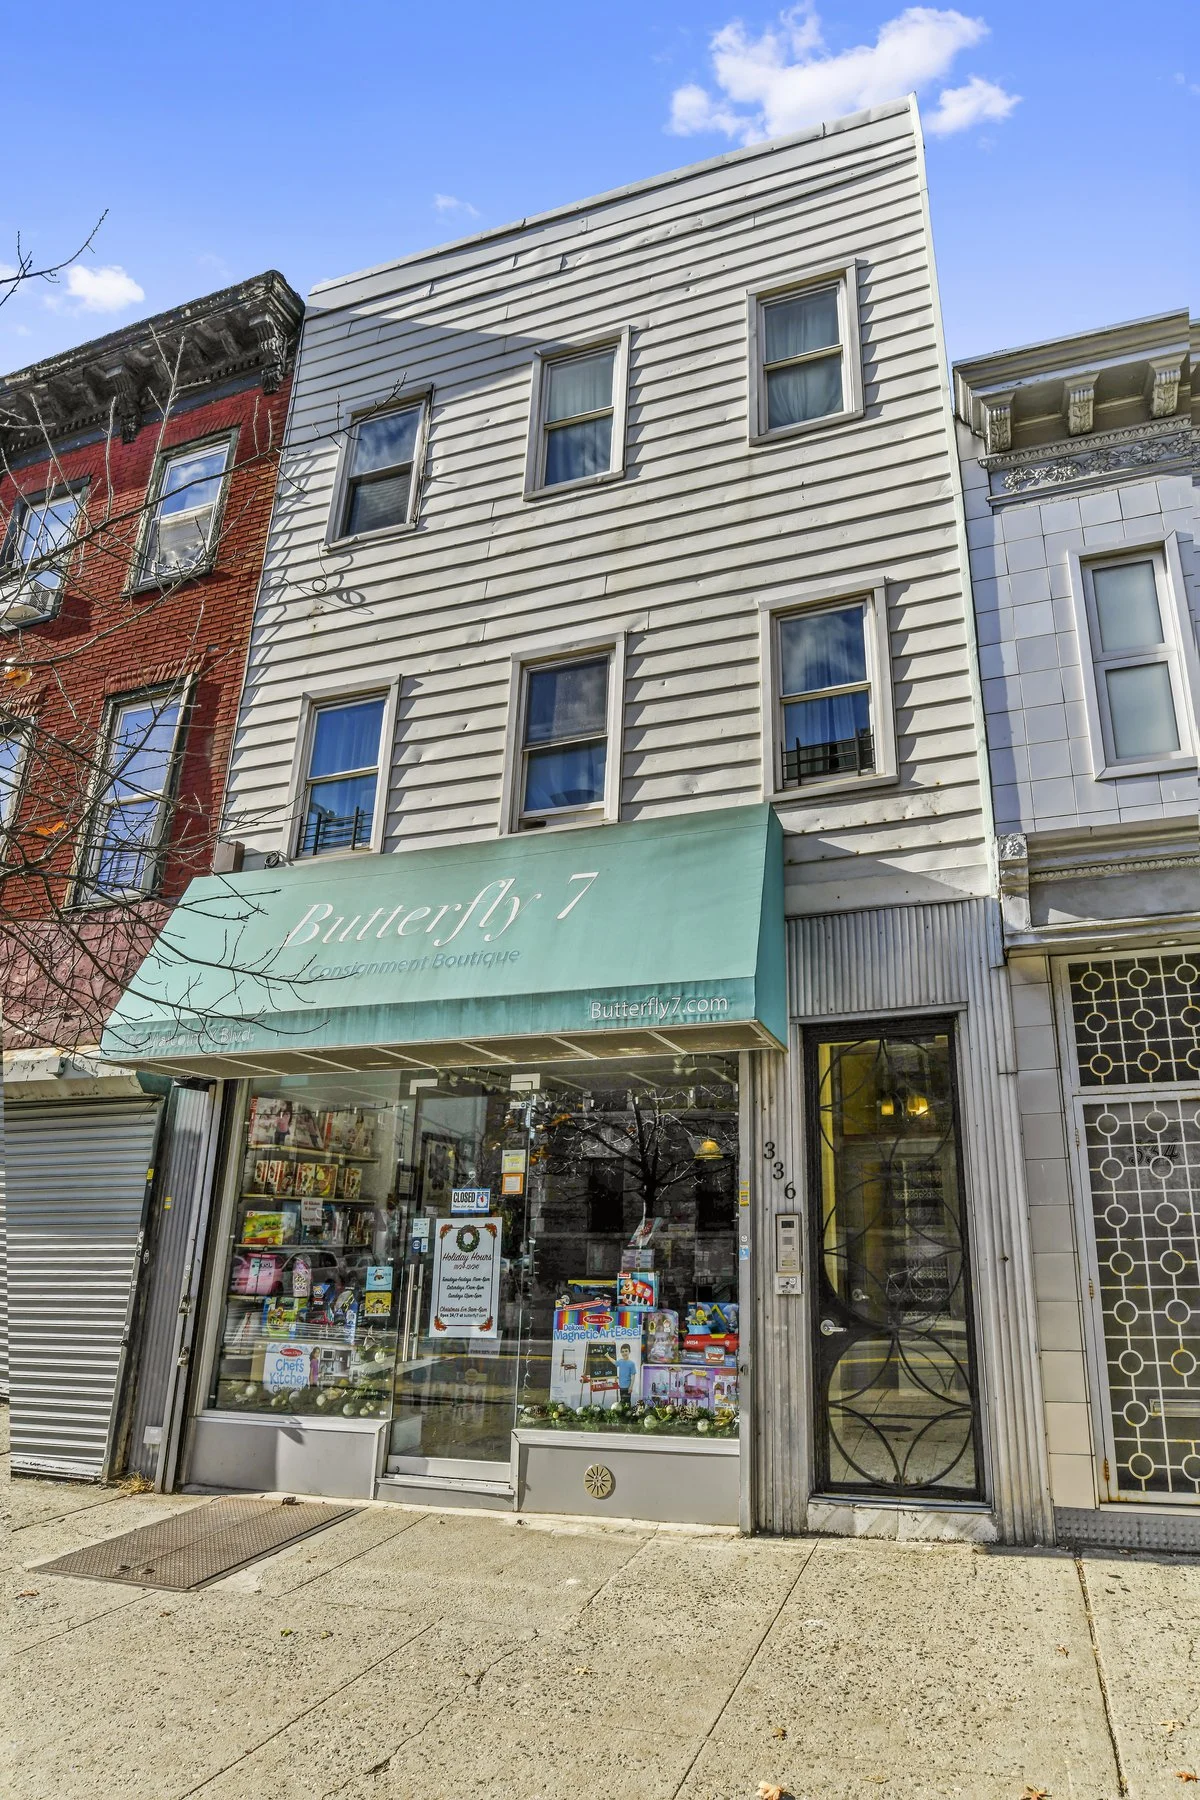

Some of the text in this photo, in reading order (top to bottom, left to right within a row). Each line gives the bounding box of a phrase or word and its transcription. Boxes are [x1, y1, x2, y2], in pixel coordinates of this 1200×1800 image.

[281, 871, 600, 948] Butterfly 7
[308, 948, 521, 980] Consignment Boutique
[591, 996, 728, 1020] Butterfly7.com
[763, 1141, 797, 1200] 336
[453, 1191, 476, 1203] CLOSED
[442, 1252, 492, 1266] Holiday Hours
[553, 1329, 598, 1343] Magnetic
[275, 1358, 305, 1373] Chef's
[269, 1371, 309, 1386] Kitchen
